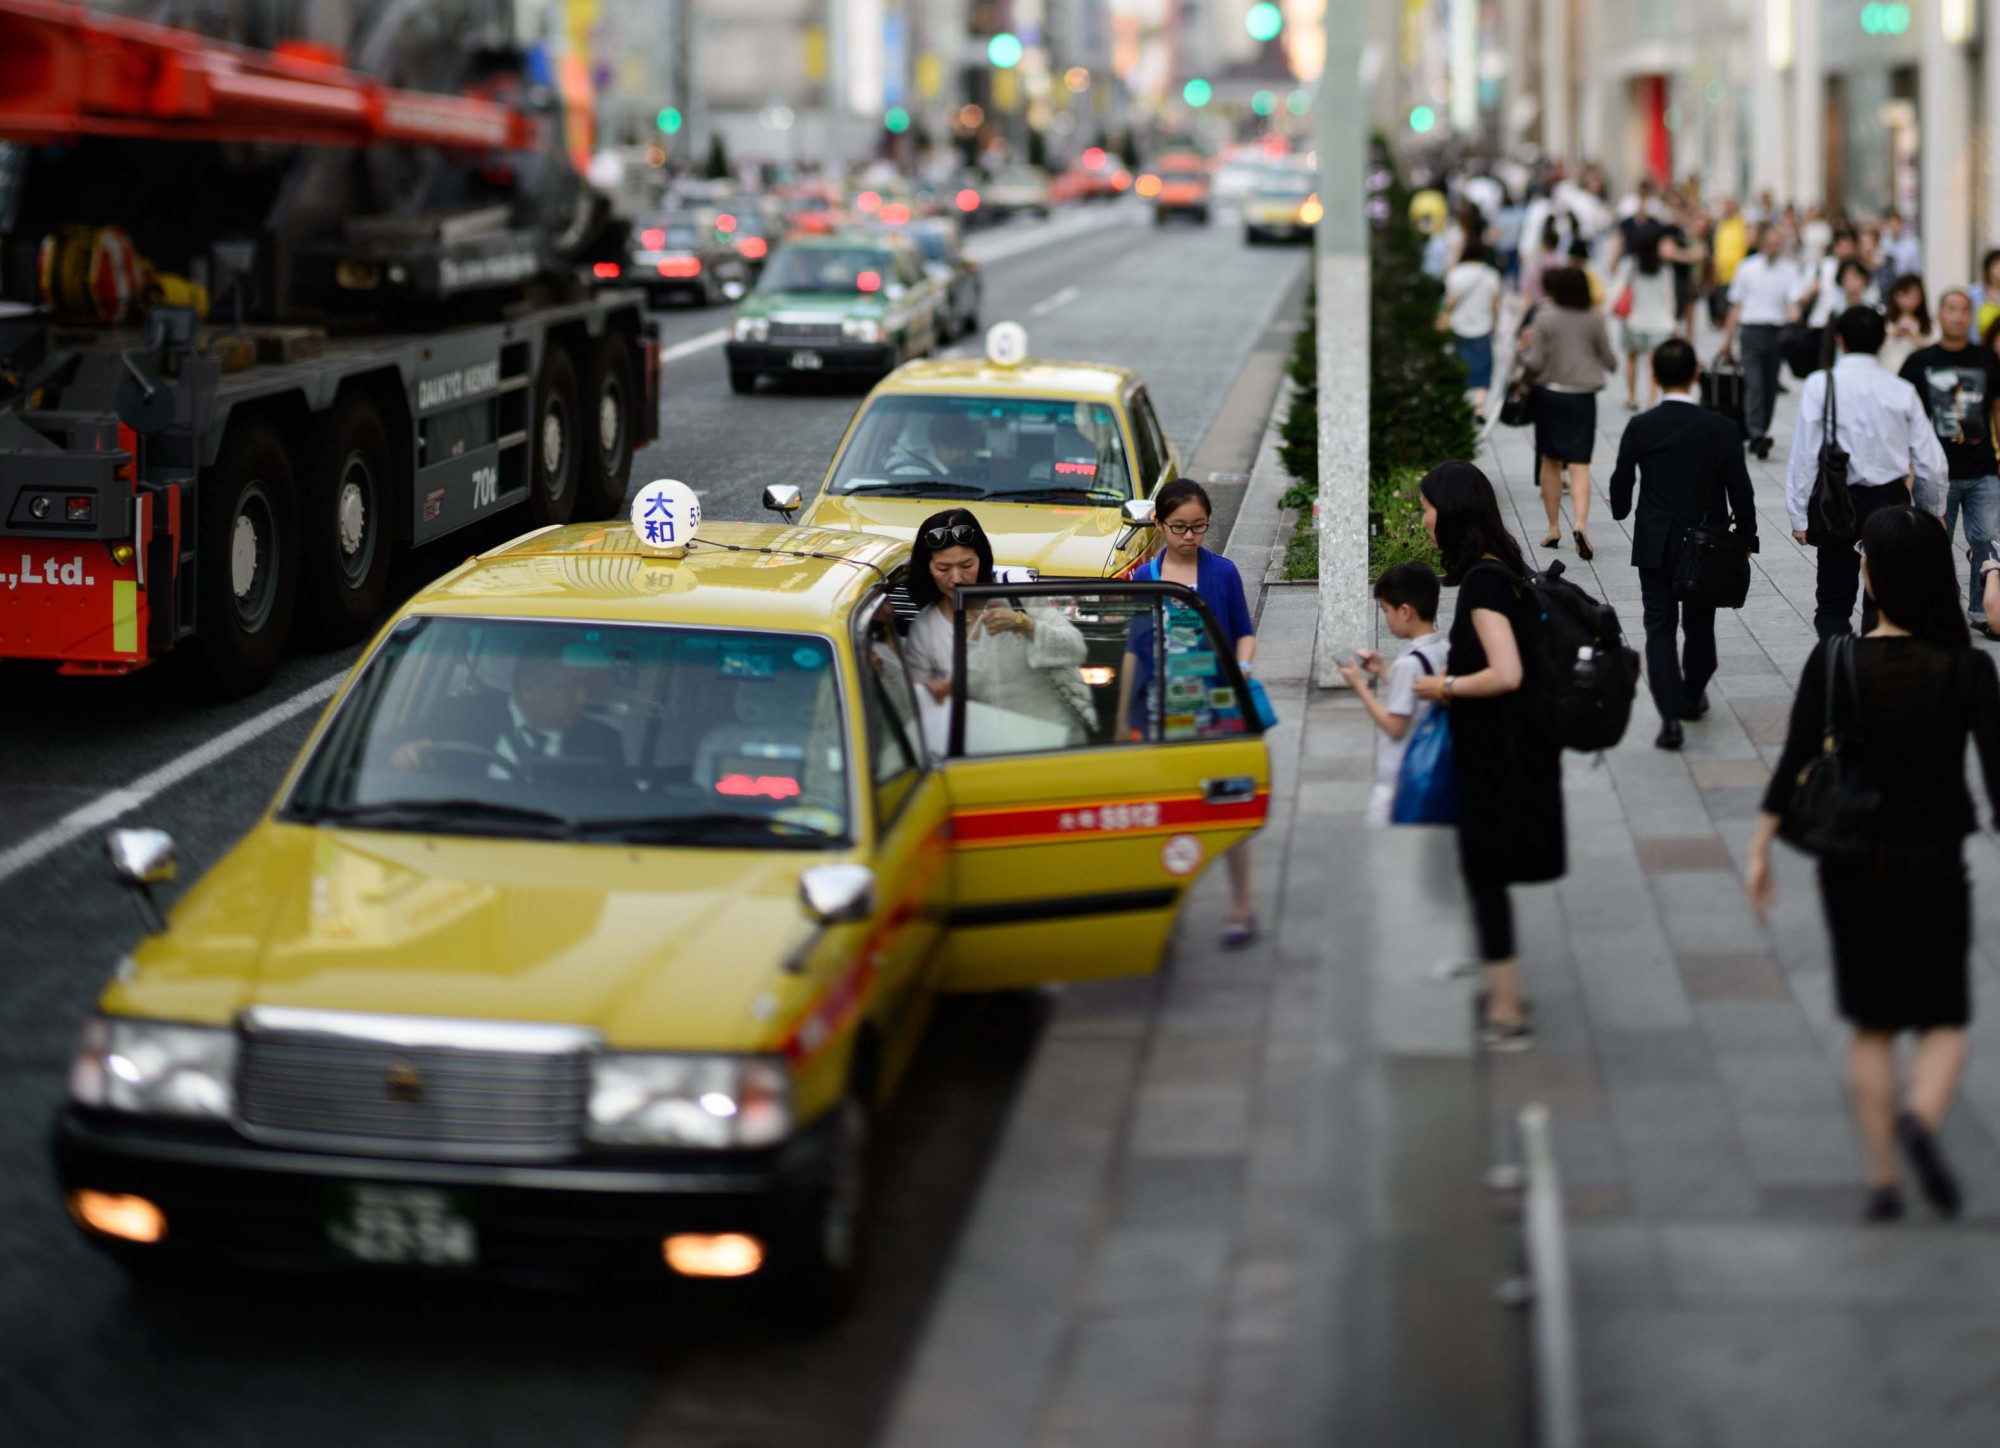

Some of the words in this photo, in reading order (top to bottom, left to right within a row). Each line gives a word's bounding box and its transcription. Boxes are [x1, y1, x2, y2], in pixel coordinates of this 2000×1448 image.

[419, 369, 463, 410] DAIKYO
[472, 467, 497, 510] 70t
[644, 492, 675, 543] 大和
